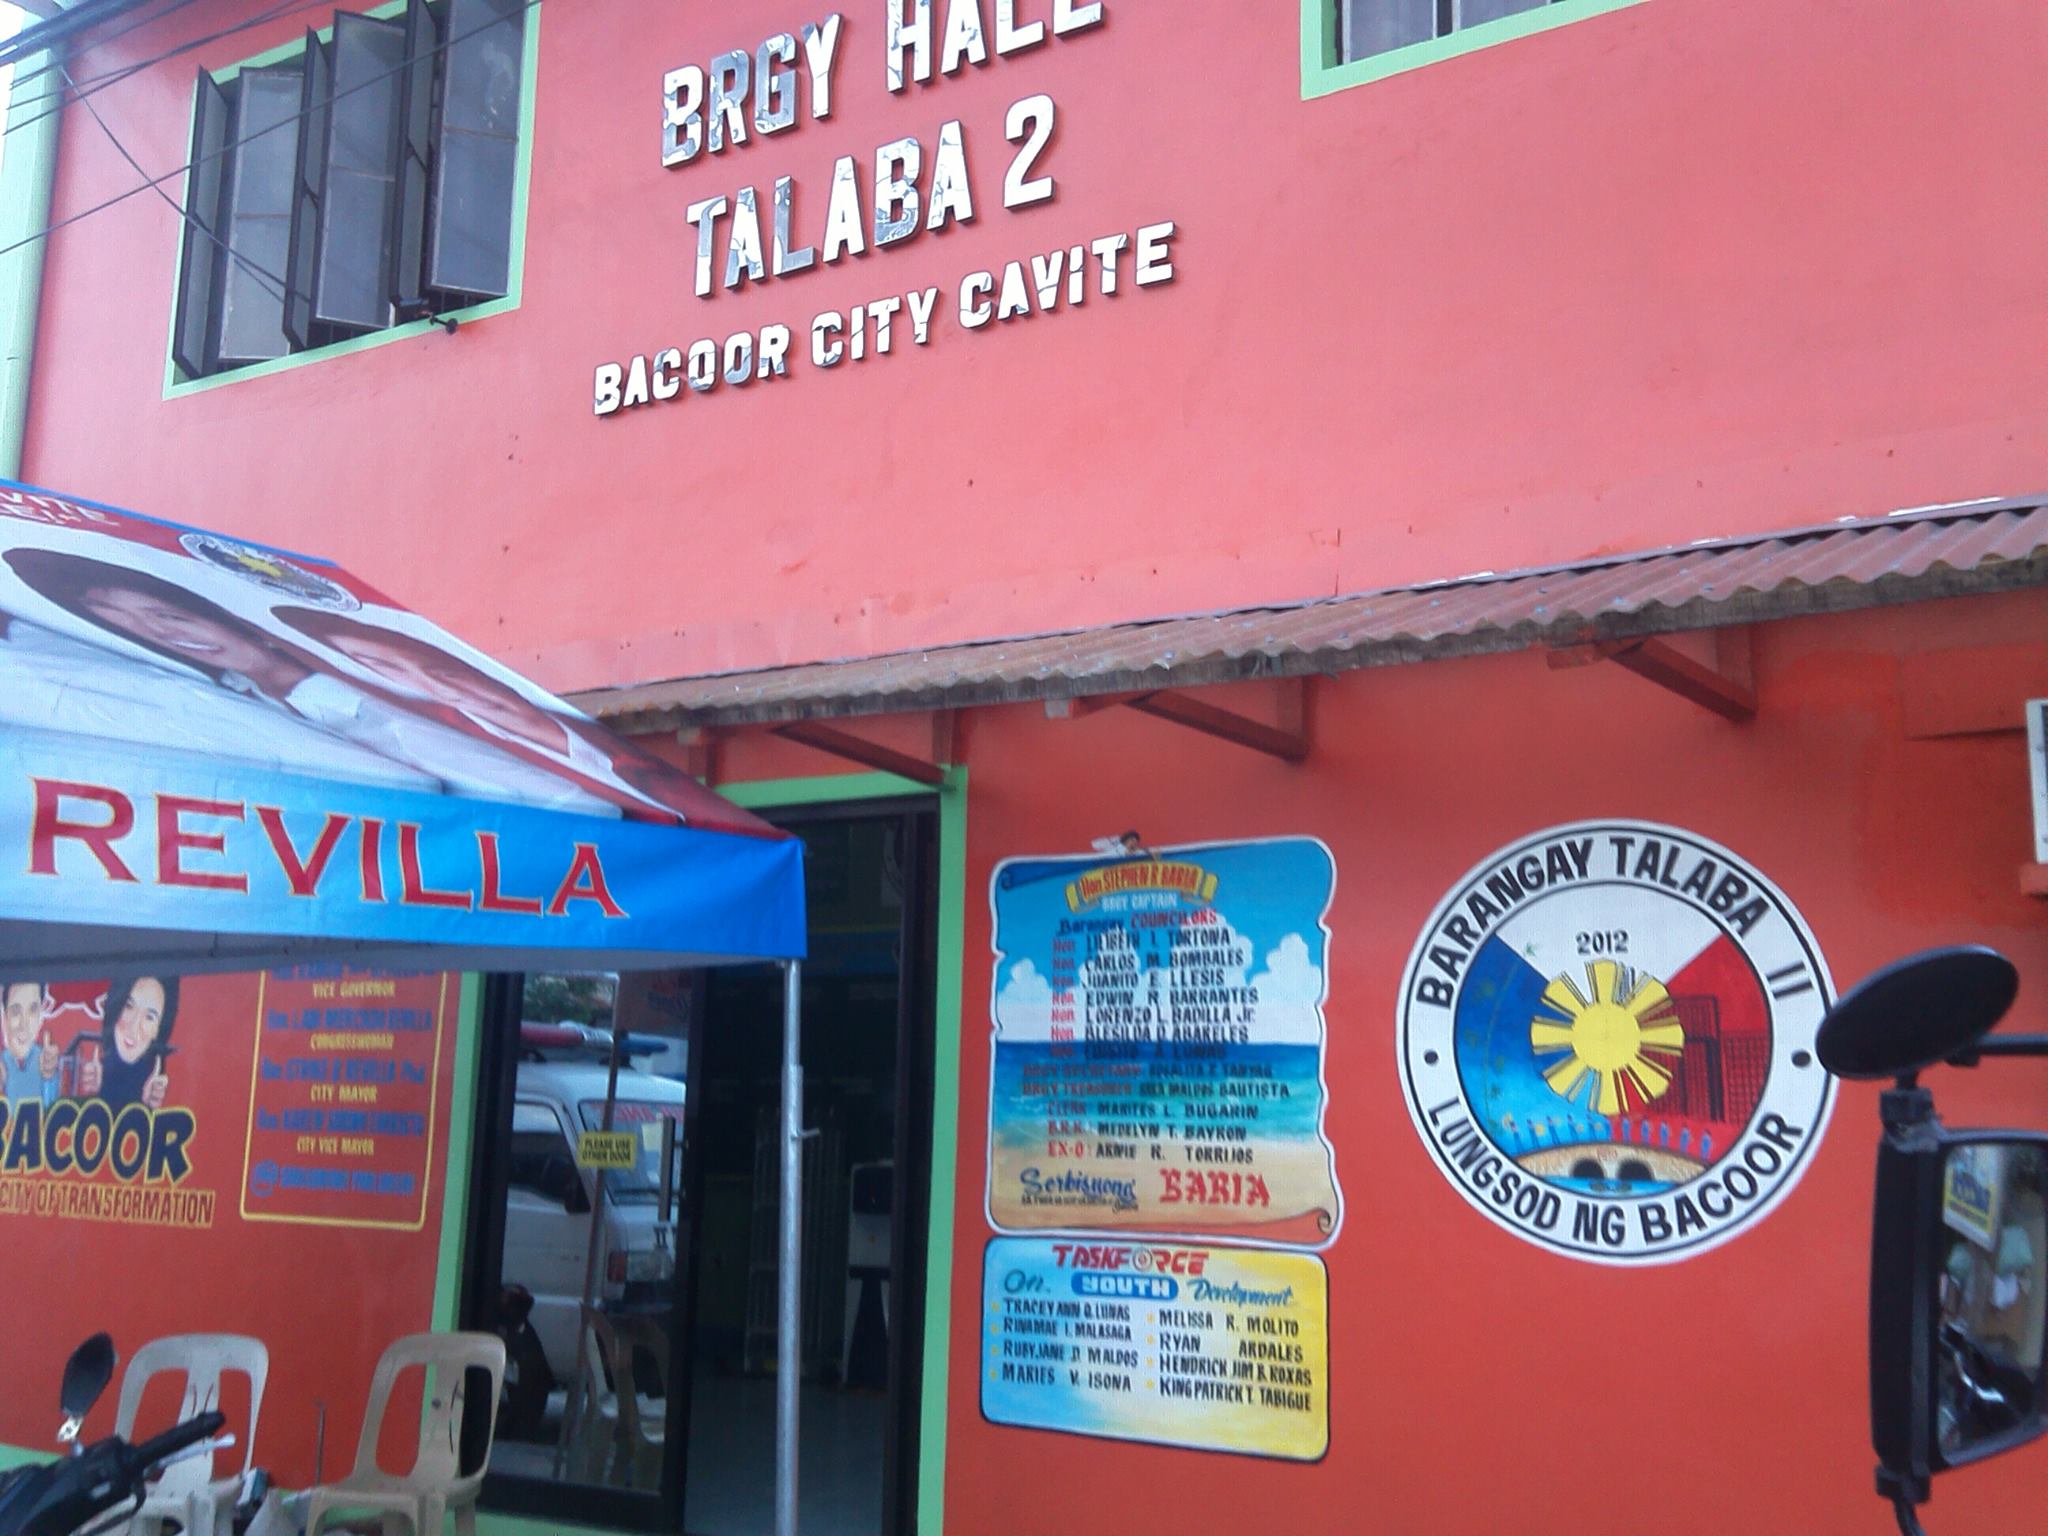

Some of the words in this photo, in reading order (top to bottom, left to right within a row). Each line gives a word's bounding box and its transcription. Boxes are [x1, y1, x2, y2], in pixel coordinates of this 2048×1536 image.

[661, 13, 843, 168] BRGY
[686, 120, 973, 297] TALABA
[1003, 94, 1057, 209] 2
[593, 323, 792, 416] BACOOR
[811, 287, 940, 368] CITY
[959, 221, 1177, 329] CAVITE
[26, 775, 627, 918] REVILLA
[1417, 838, 1593, 1009] BARANGAY
[1610, 837, 1770, 937] TALABA
[1767, 961, 1814, 1000] II
[1576, 931, 1629, 954] 2012
[1085, 954, 1135, 973] CARLOS
[1086, 991, 1134, 1006] EDWIN
[1086, 1007, 1150, 1024] LORENZO
[311, 1085, 334, 1102] CITY
[1219, 1082, 1290, 1098] BAUTISTA
[1097, 1101, 1156, 1117] MARITES
[1185, 1102, 1260, 1120] BUGARIN
[0, 1096, 196, 1185] ACOOR
[1185, 1124, 1247, 1142] BAYRON
[1185, 1144, 1254, 1163] TORRIJOS
[1429, 1097, 1561, 1231] LUNGSOD
[1572, 1201, 1626, 1246] NG
[1639, 1113, 1804, 1246] BACOOR
[1159, 1167, 1271, 1208] BARIA
[59, 1181, 216, 1228] TRANSFORMATION
[1082, 1276, 1171, 1298] YOUTH
[1159, 1310, 1214, 1330] MELISSA
[1247, 1316, 1299, 1337] MOLITO
[1088, 1349, 1139, 1369] MALDOS
[1159, 1333, 1201, 1352] RYAN
[1238, 1340, 1304, 1364] ARDALES
[1088, 1372, 1132, 1393] ISONA
[1159, 1353, 1227, 1377] HENDRICK
[1231, 1361, 1254, 1381] JIM
[1270, 1365, 1313, 1387] ROXAS
